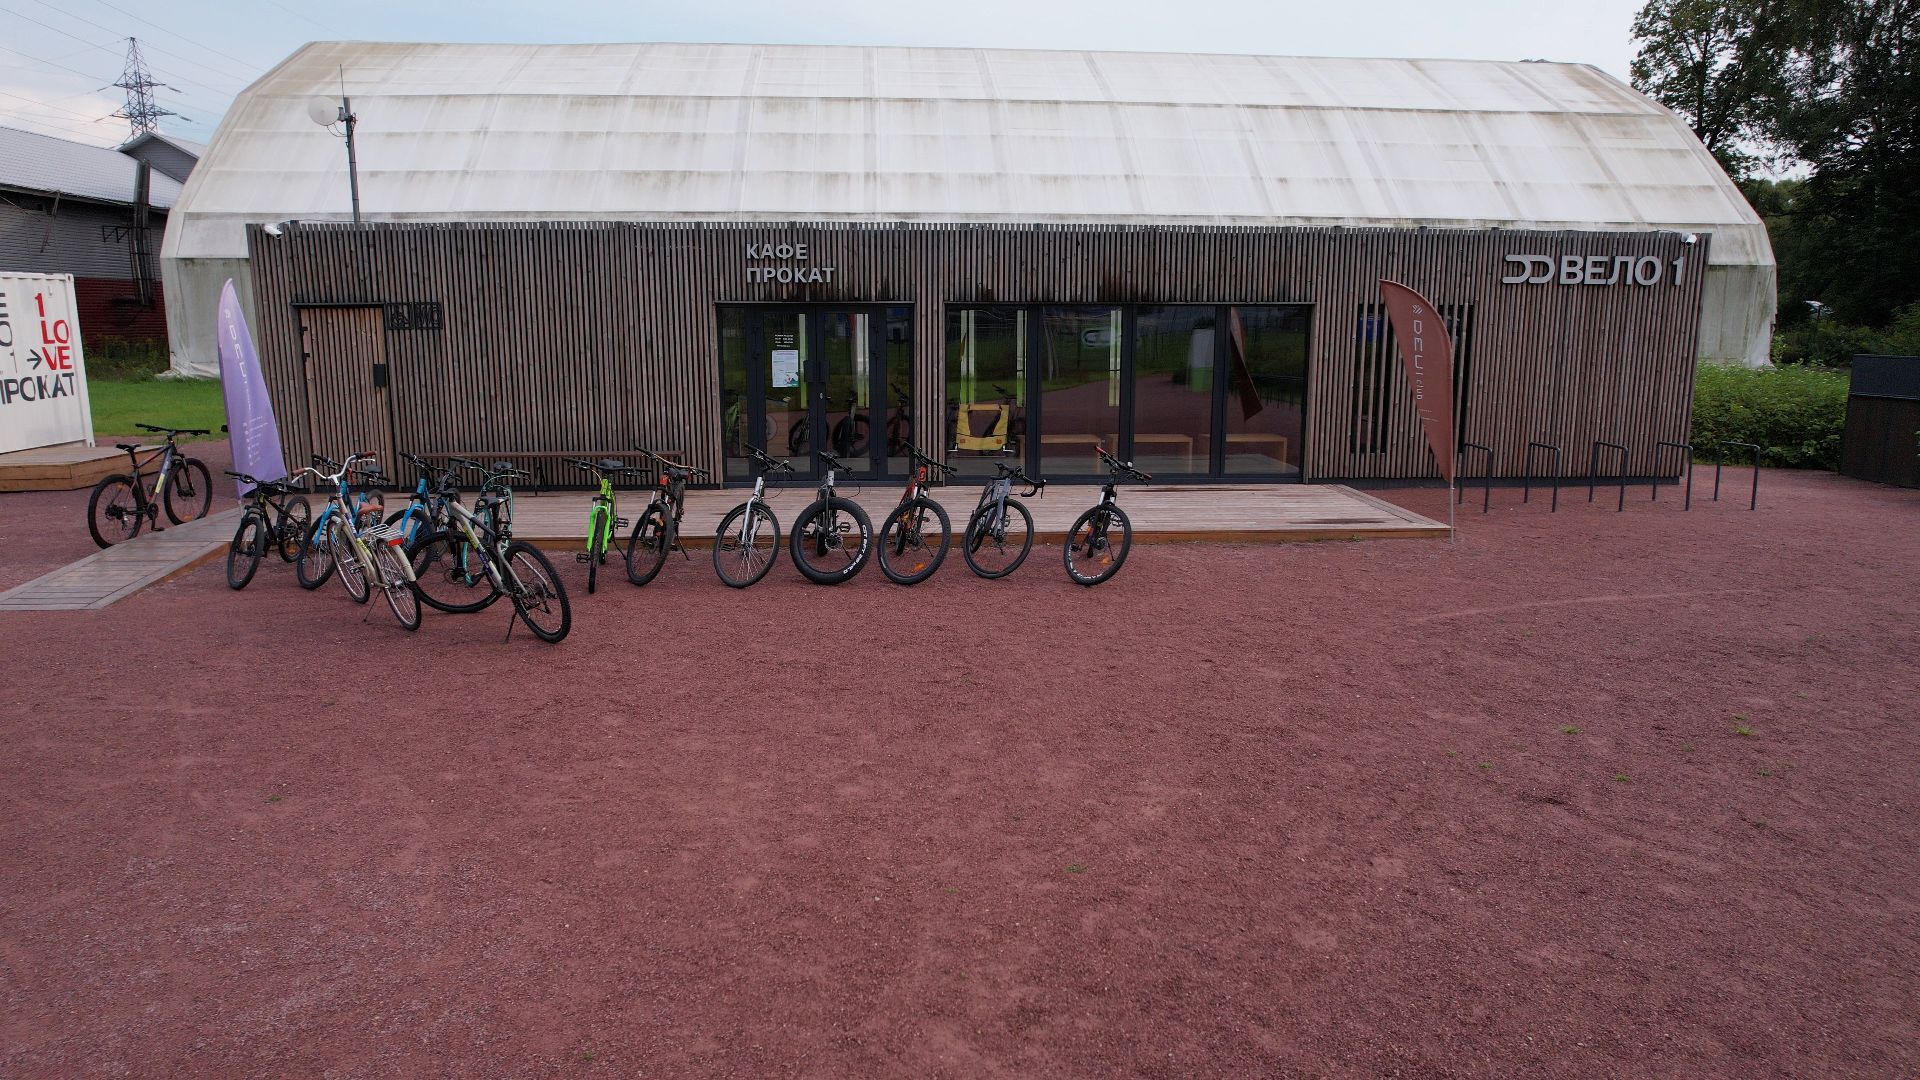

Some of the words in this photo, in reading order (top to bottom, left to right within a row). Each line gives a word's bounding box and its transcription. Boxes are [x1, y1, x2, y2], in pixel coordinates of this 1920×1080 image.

[747, 242, 808, 260] КАФЕ
[747, 267, 835, 283] ПРОКАТ
[1559, 255, 1663, 286] ВЕЛО
[1672, 255, 1684, 286] 1
[34, 292, 45, 317] 1
[41, 320, 69, 344] LO
[42, 345, 73, 371] VE
